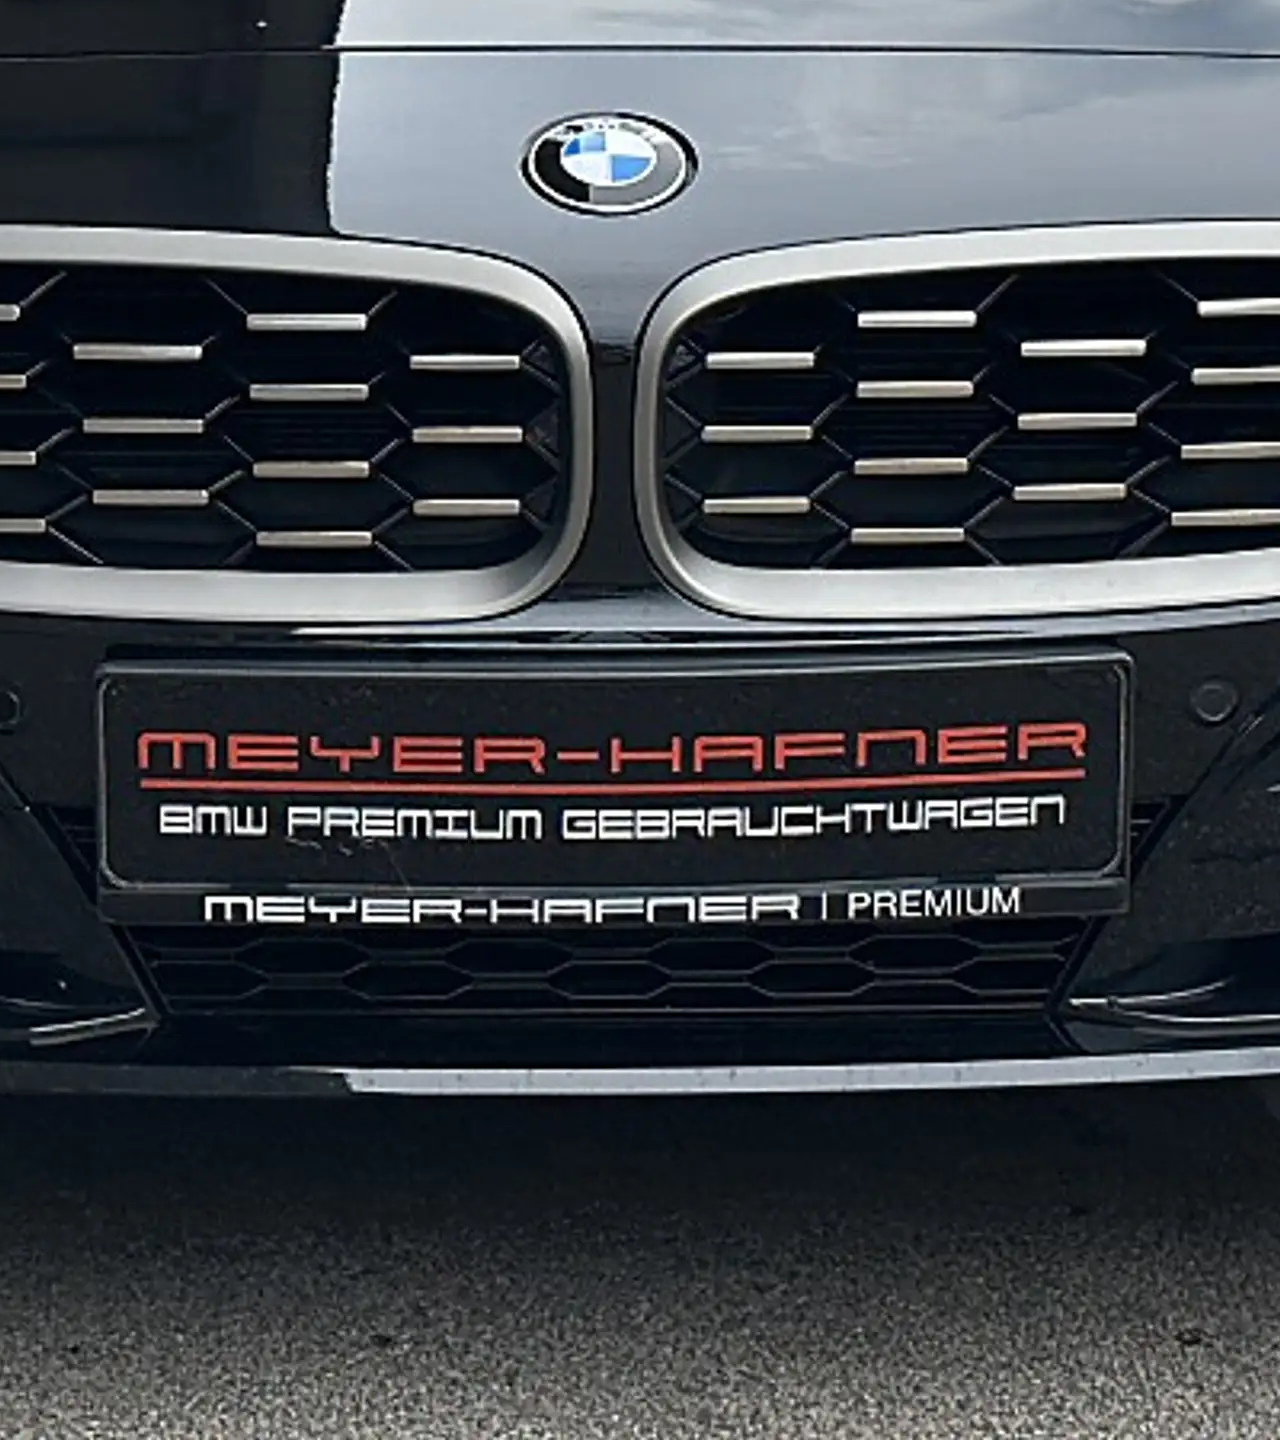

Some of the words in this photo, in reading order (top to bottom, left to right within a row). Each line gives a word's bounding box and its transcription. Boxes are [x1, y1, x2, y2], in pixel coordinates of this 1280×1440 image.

[137, 720, 1089, 775] MEYER-HAFNER
[158, 803, 269, 837] BMW
[286, 805, 544, 841] PREMIUM
[561, 793, 1066, 841] GEBRAUCHTWAGEN
[203, 892, 802, 925] MEYER-HAFNER
[846, 884, 1022, 920] PREMIUM
